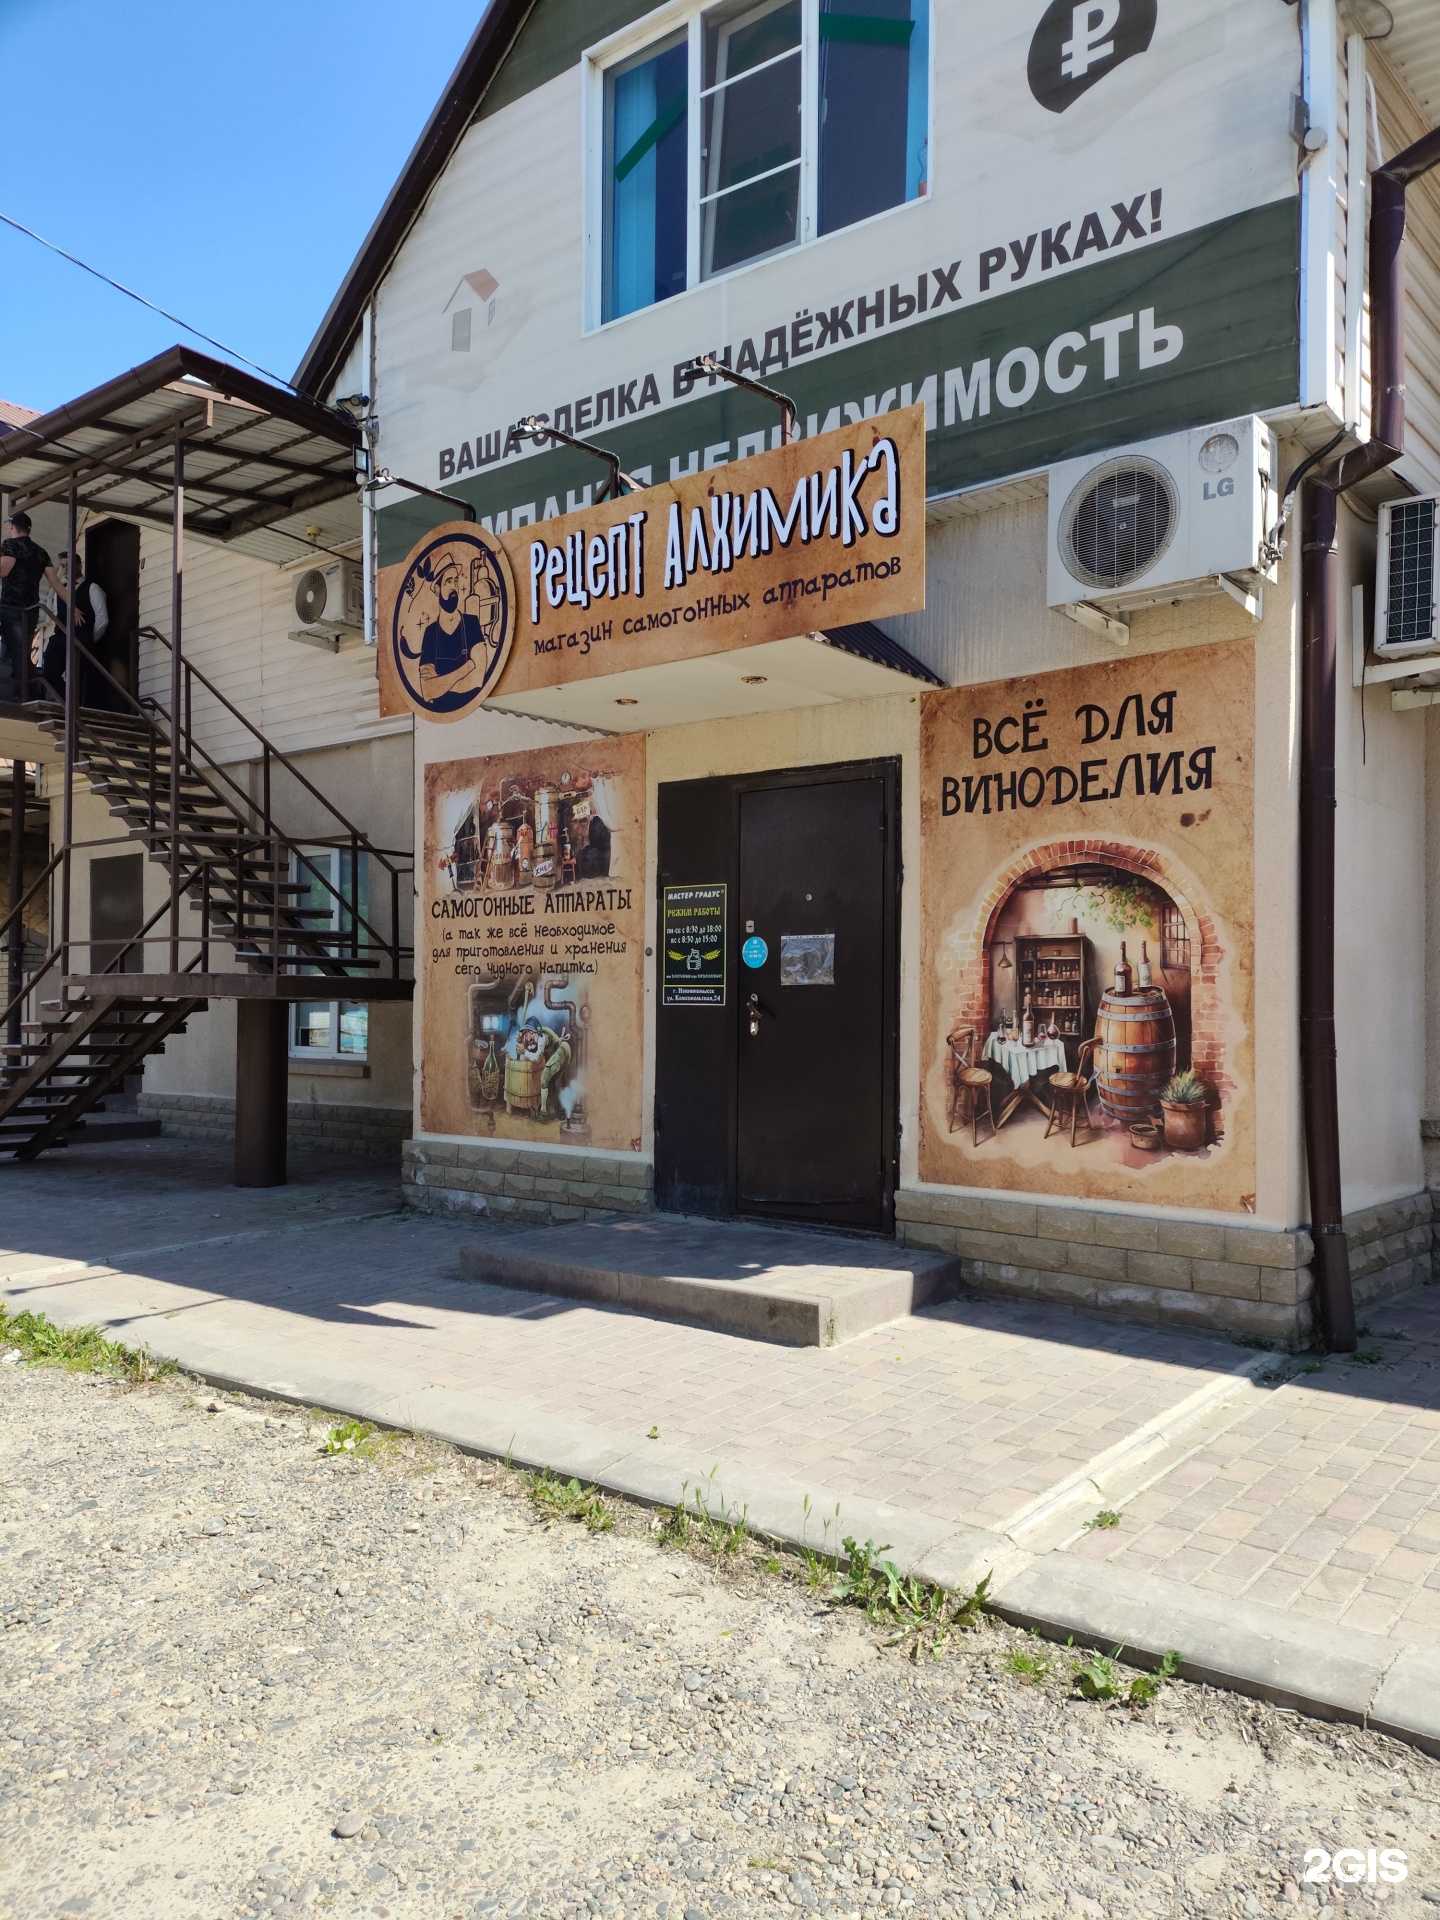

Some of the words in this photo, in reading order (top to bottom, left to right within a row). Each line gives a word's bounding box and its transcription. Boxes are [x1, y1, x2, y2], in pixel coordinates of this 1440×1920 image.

[979, 187, 1163, 293] РУКАХ!
[1203, 477, 1234, 500] LG
[534, 619, 613, 656] магазин
[623, 590, 751, 636] самогонных
[762, 556, 902, 602] аппаратов
[973, 698, 1049, 759] ВСЁ
[1075, 690, 1177, 744] ДЛЯ
[942, 746, 1217, 816] ВИНОДЕЛИЯ
[431, 895, 535, 919] САМОГОННЫЕ
[544, 889, 632, 914] АППАРАТЫ
[693, 906, 721, 916] РАБОТЫ
[442, 929, 453, 942] (а
[459, 927, 481, 940] так
[486, 926, 504, 939] же
[509, 923, 528, 938] всё
[432, 946, 451, 963] для
[456, 943, 545, 961] приготовления
[550, 943, 558, 955] и
[564, 941, 627, 960] хранения
[455, 963, 481, 975] сего
[487, 963, 533, 980] чудного
[539, 960, 599, 976] напитка)
